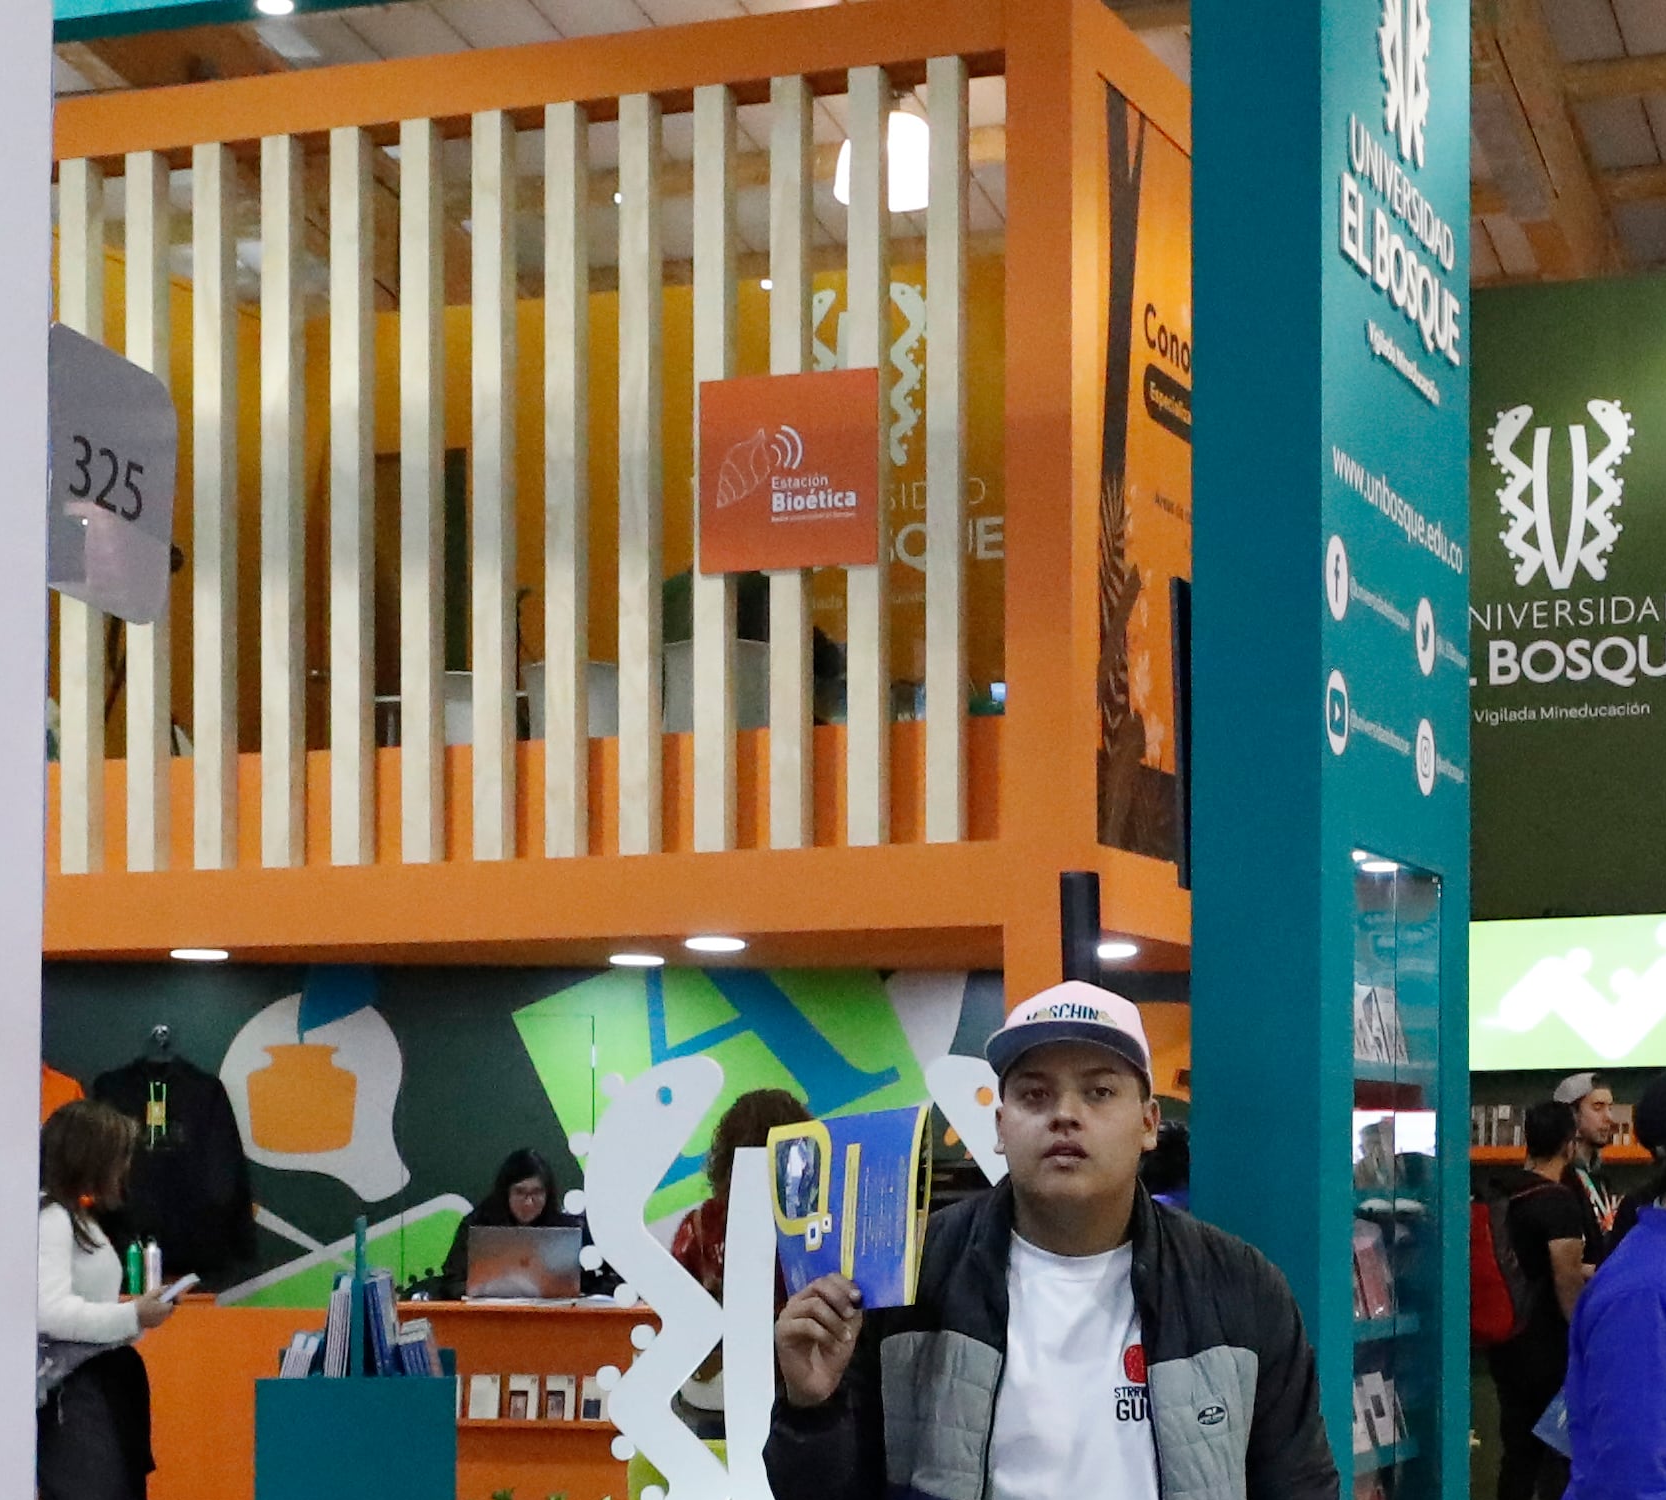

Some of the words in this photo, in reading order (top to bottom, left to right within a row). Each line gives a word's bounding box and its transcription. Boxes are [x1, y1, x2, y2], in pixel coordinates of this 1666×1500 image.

[1349, 112, 1455, 271] UNIVERSIDAD
[1340, 172, 1372, 276] EL
[1373, 208, 1461, 366] BOSQUE
[69, 434, 145, 521] 325
[771, 474, 829, 490] Estación
[771, 489, 858, 513] Bioética
[1333, 445, 1464, 575] www.unbosque.edu.co
[1473, 706, 1536, 726] Vigilada
[1540, 702, 1651, 721] Mineducación
[1026, 1003, 1113, 1024] SCHIN
